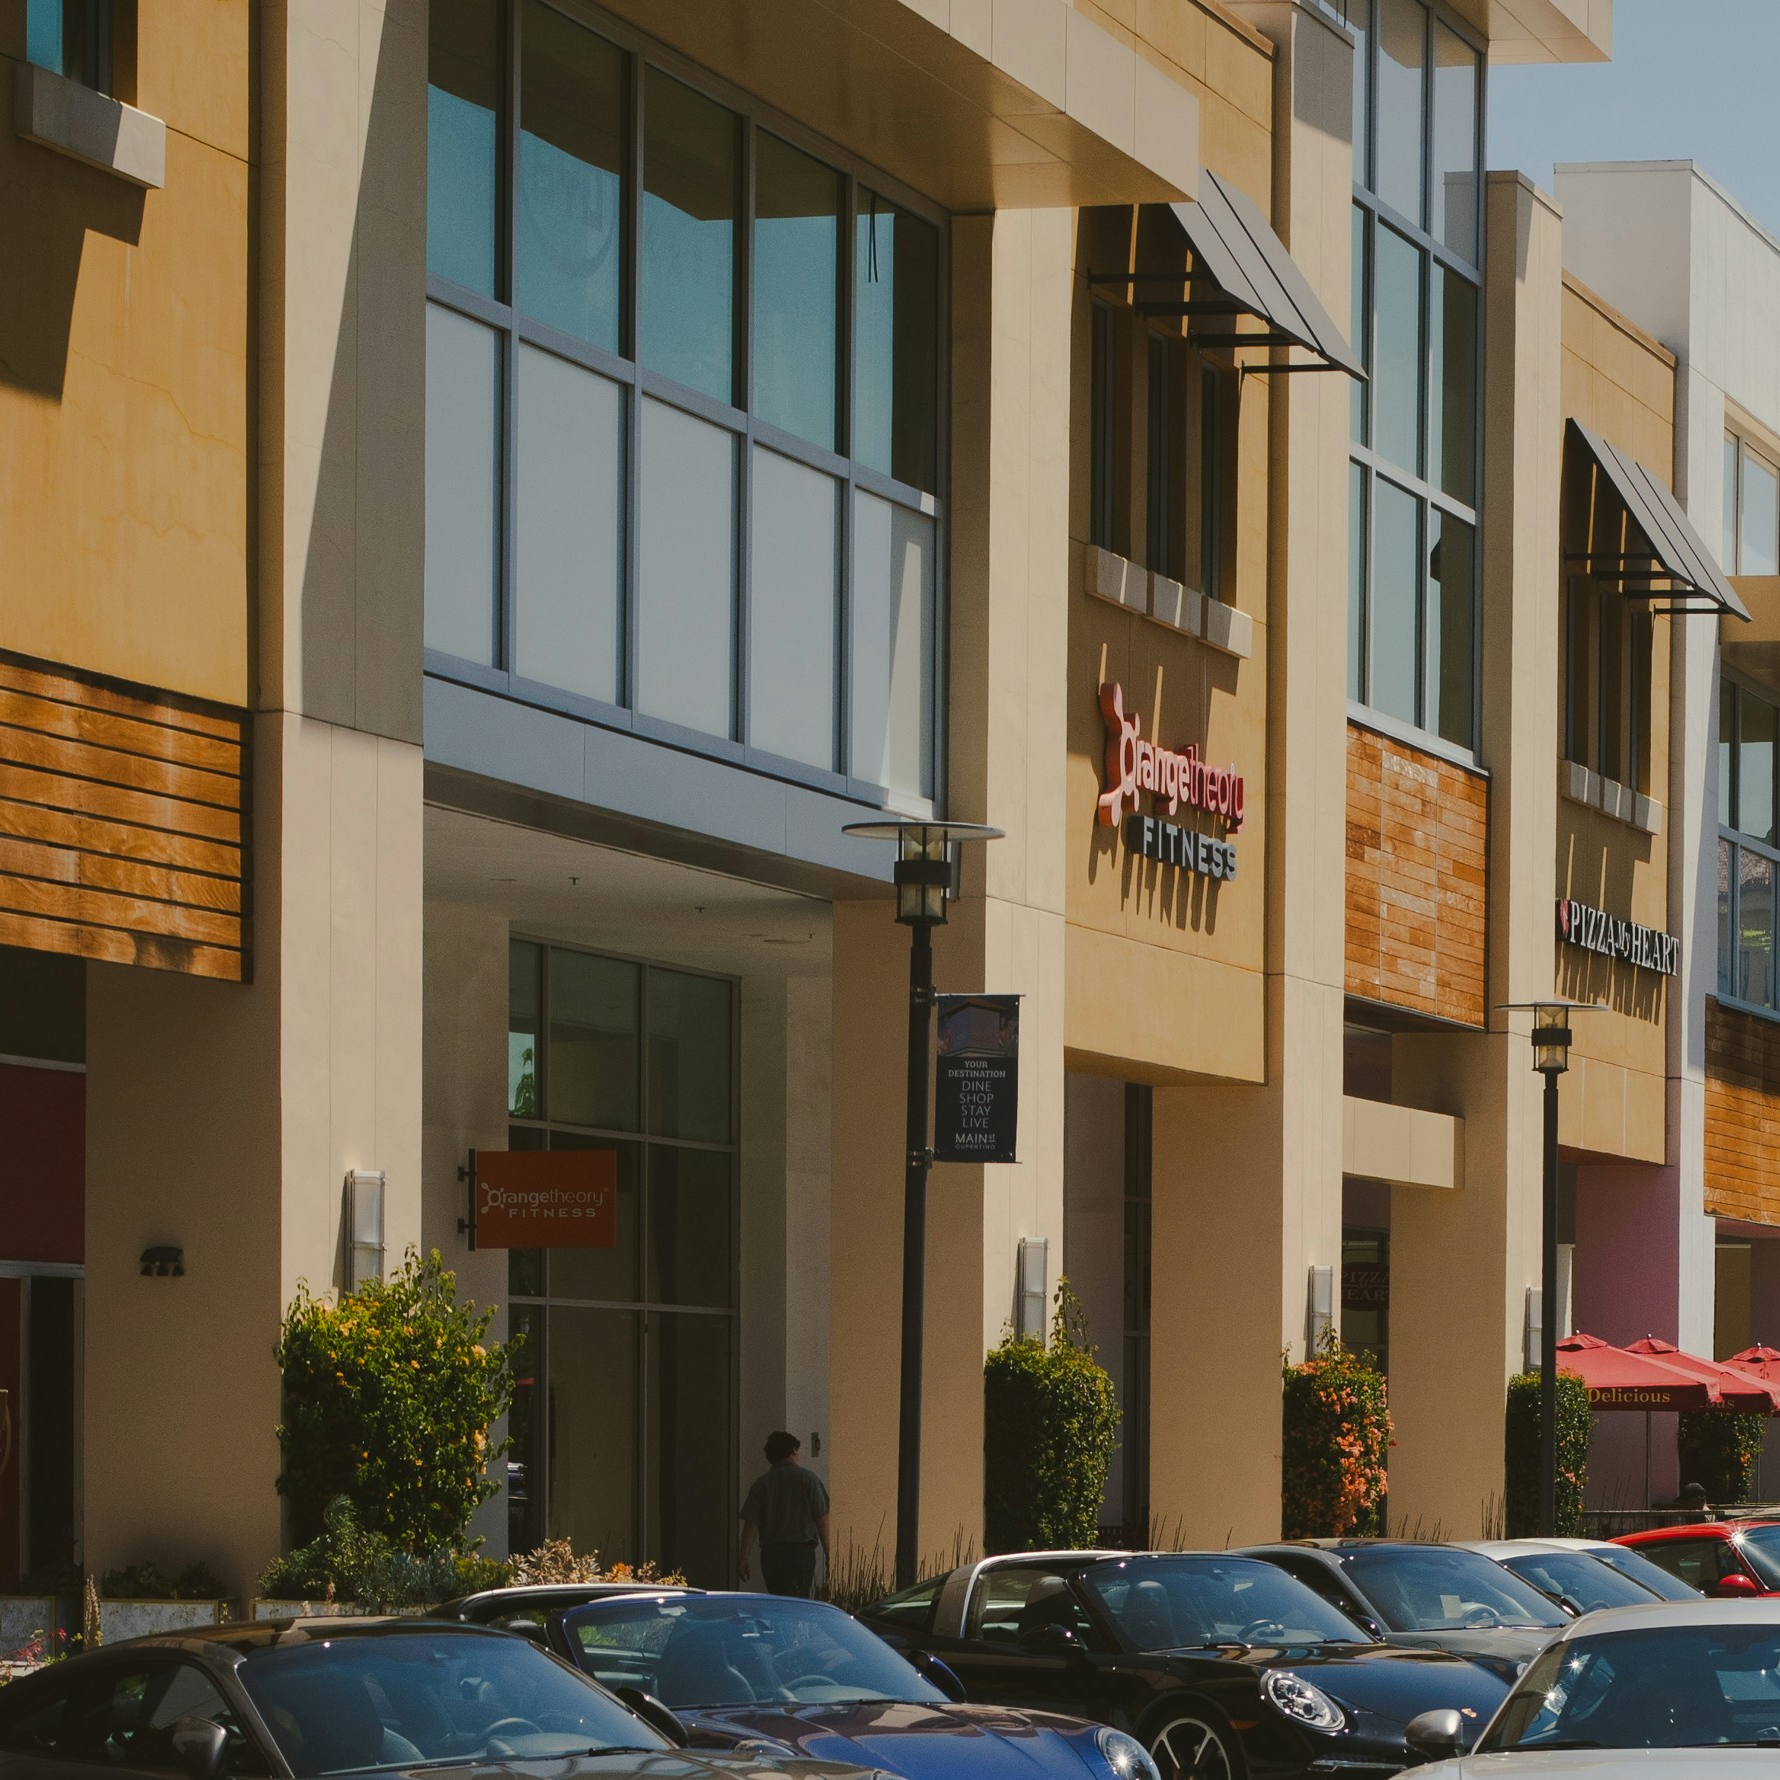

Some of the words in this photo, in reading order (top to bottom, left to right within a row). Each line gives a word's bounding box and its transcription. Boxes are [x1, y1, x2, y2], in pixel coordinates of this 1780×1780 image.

[1136, 815, 1238, 881] FITNESS
[1570, 900, 1616, 957] PIZZA
[1630, 922, 1680, 977] HEART
[964, 1060, 988, 1068] YOUR
[948, 1070, 1006, 1078] DESTINATION
[962, 1081, 991, 1091] DINE
[959, 1092, 994, 1104] SHOP
[961, 1105, 991, 1116] STAY
[962, 1117, 989, 1128] LIVE
[955, 1133, 987, 1143] MAIN
[509, 1208, 597, 1218] FITNESS
[1587, 1388, 1671, 1403] Delicious
